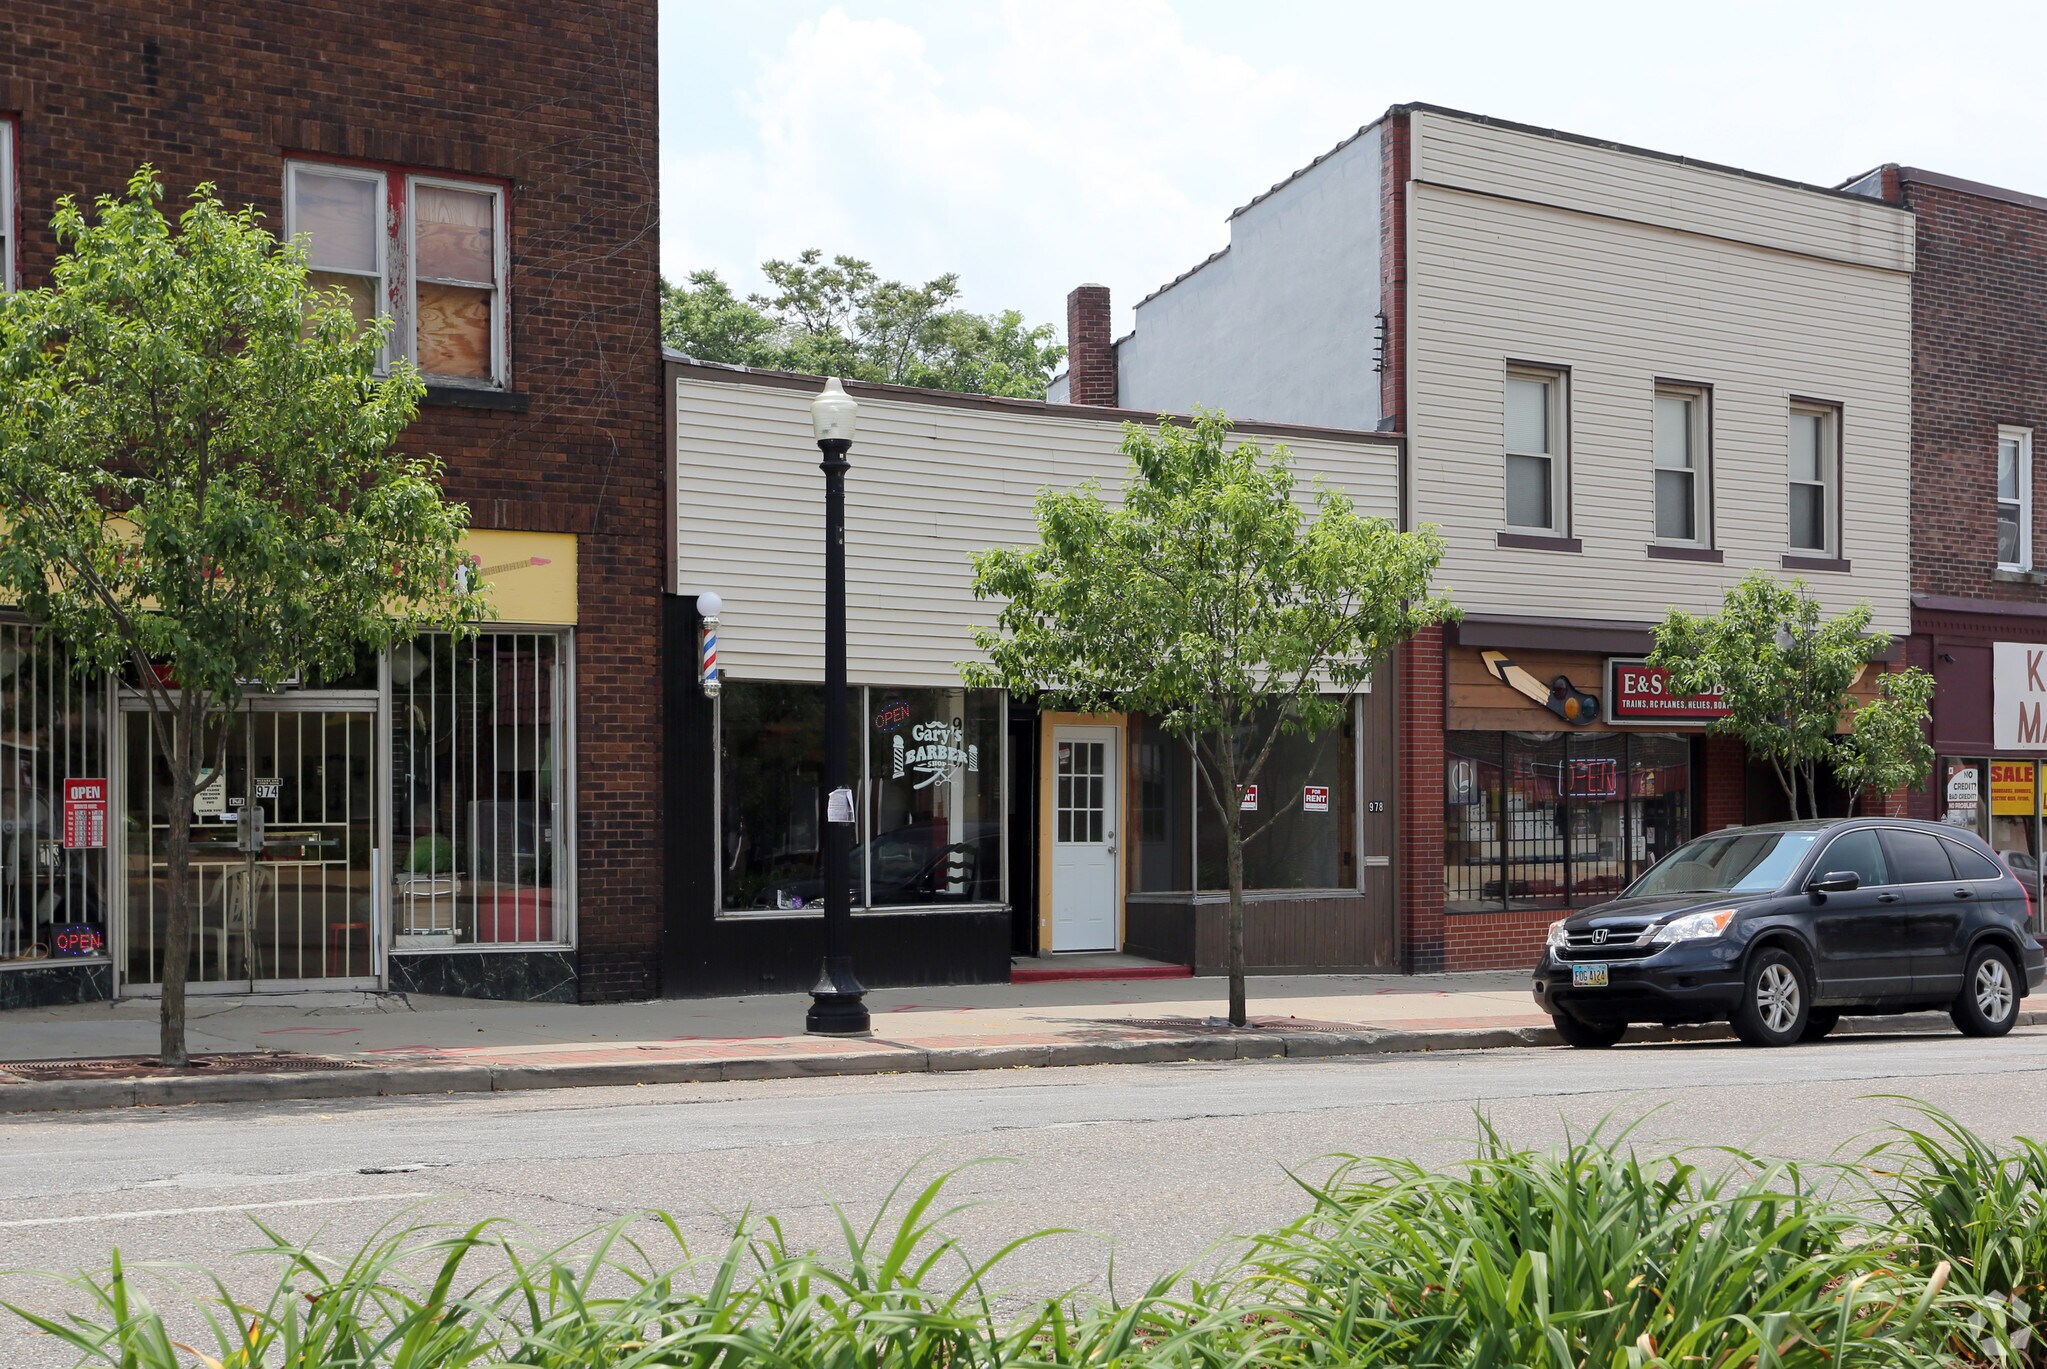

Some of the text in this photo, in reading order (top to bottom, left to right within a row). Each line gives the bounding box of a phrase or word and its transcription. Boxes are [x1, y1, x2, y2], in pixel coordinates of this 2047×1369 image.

[1624, 673, 1662, 694] E&S
[1622, 700, 1730, 709] TRAINS, RC PLANES, HELIES, BOA
[876, 704, 910, 728] OPEN
[912, 724, 963, 745] Gary's
[905, 745, 968, 765] BARBER
[1964, 771, 1973, 779] NO
[1991, 766, 2033, 782] SALE
[257, 786, 277, 797] 974
[1953, 782, 1976, 790] CREDIT?
[71, 786, 100, 799] OPEN
[1244, 794, 1255, 802] NT
[1306, 795, 1327, 803] RENT
[1369, 802, 1384, 812] 978
[57, 934, 101, 949] OPEN
